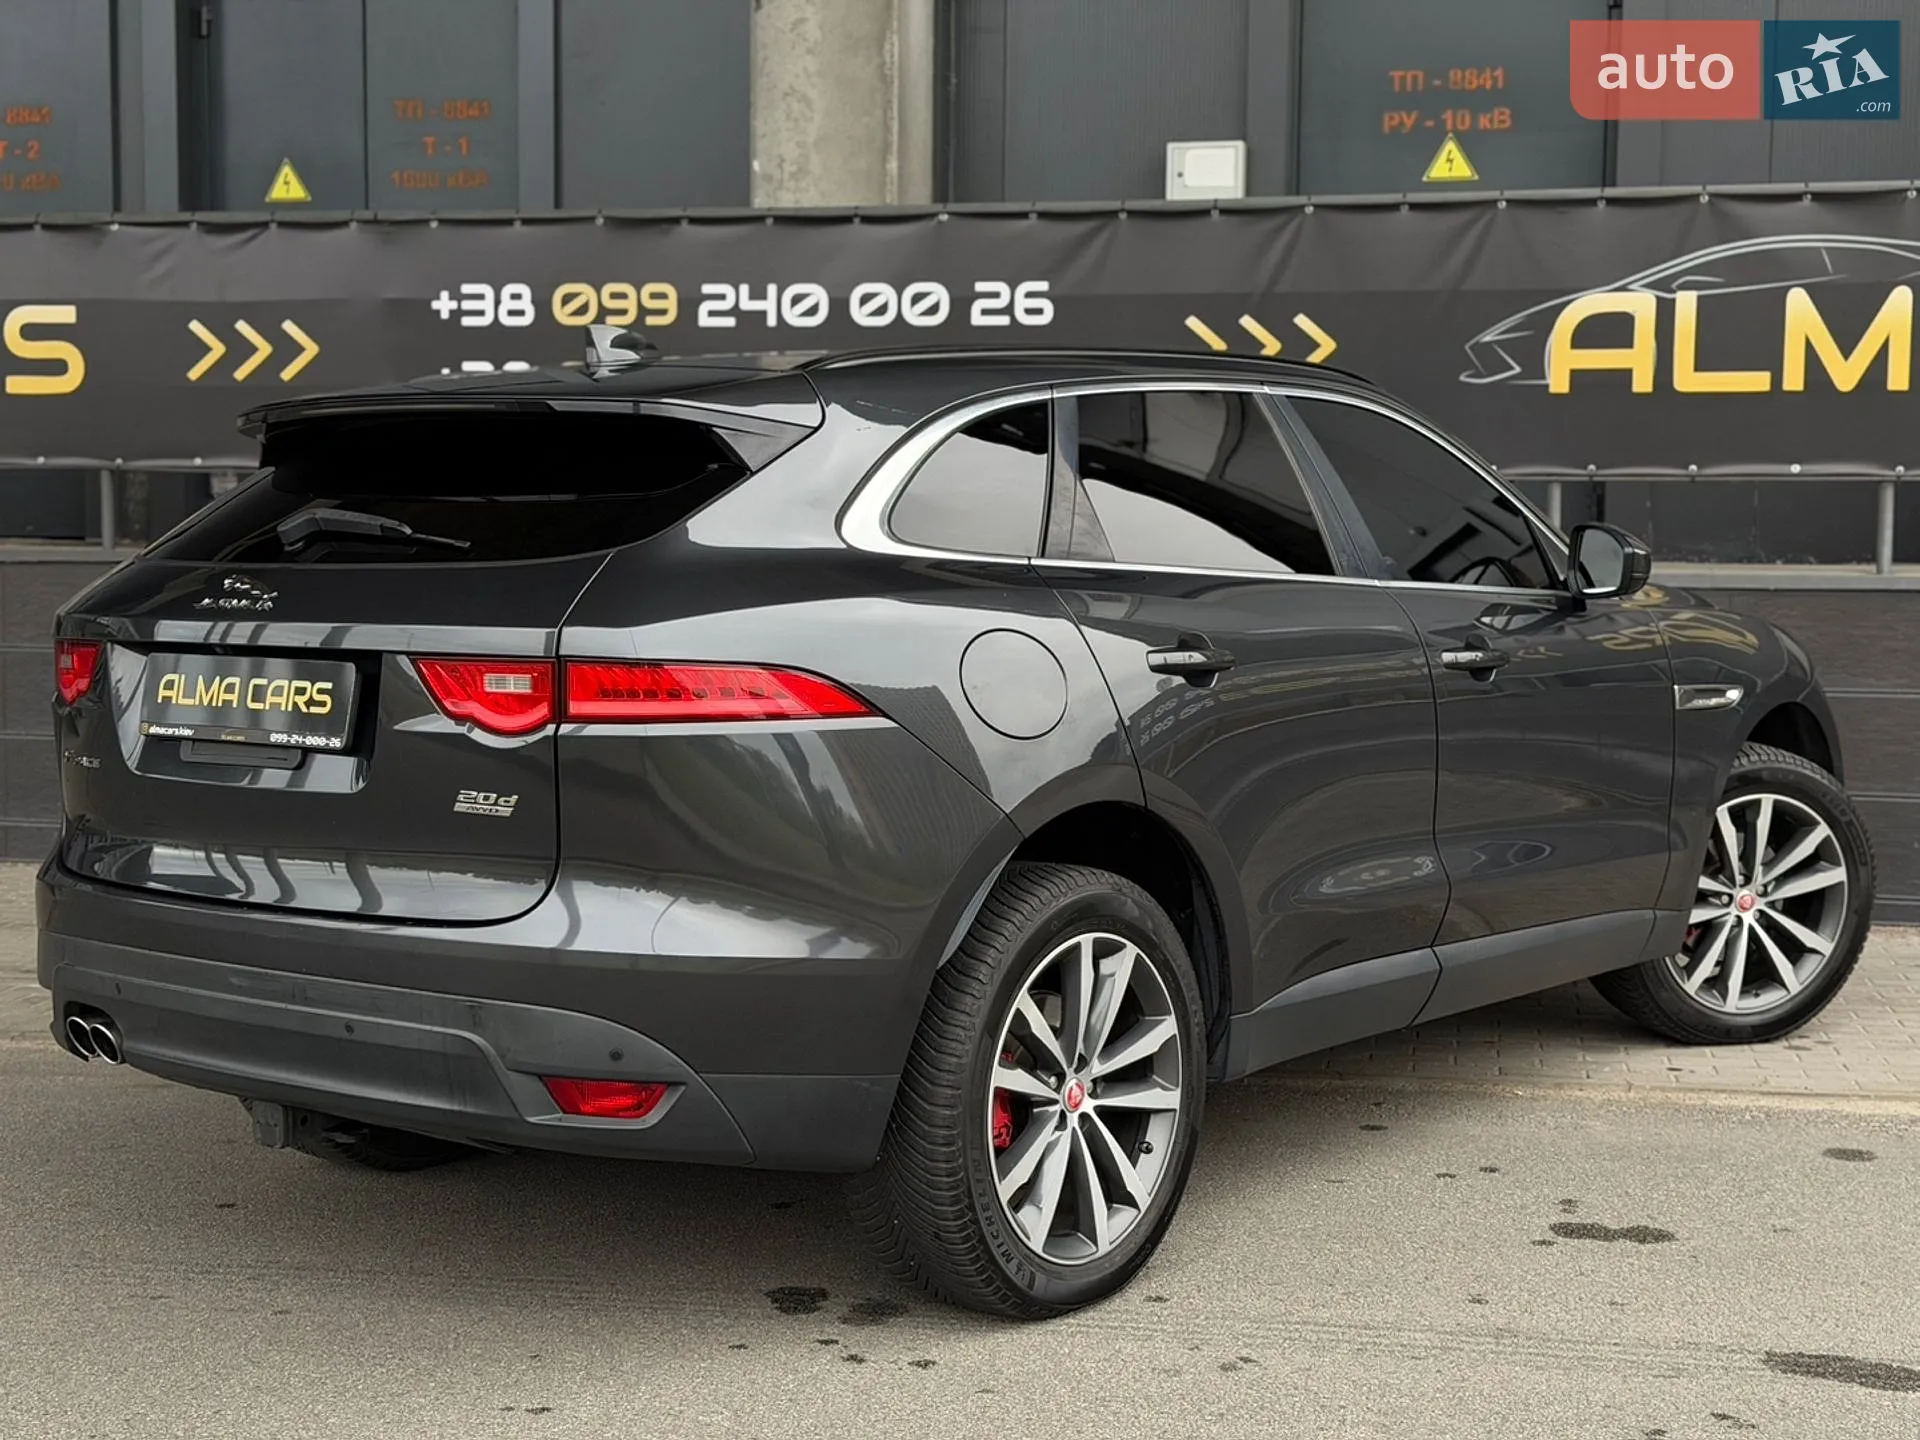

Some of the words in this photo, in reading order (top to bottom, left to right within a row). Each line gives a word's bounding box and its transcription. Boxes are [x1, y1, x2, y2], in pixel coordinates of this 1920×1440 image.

[1388, 70, 1424, 92] ТП
[1448, 66, 1504, 91] 8841
[1382, 110, 1418, 134] РУ
[1441, 109, 1471, 131] 10
[26, 140, 40, 161] 2
[431, 283, 535, 327] +38
[551, 283, 679, 327] 099
[698, 282, 828, 327] 240
[849, 281, 950, 327] 00
[970, 280, 1055, 326] 26
[3, 305, 85, 395] S
[1548, 285, 1914, 393] ALM
[157, 673, 242, 708] ALMA
[246, 677, 334, 714] CARS
[456, 789, 519, 807] 20d
